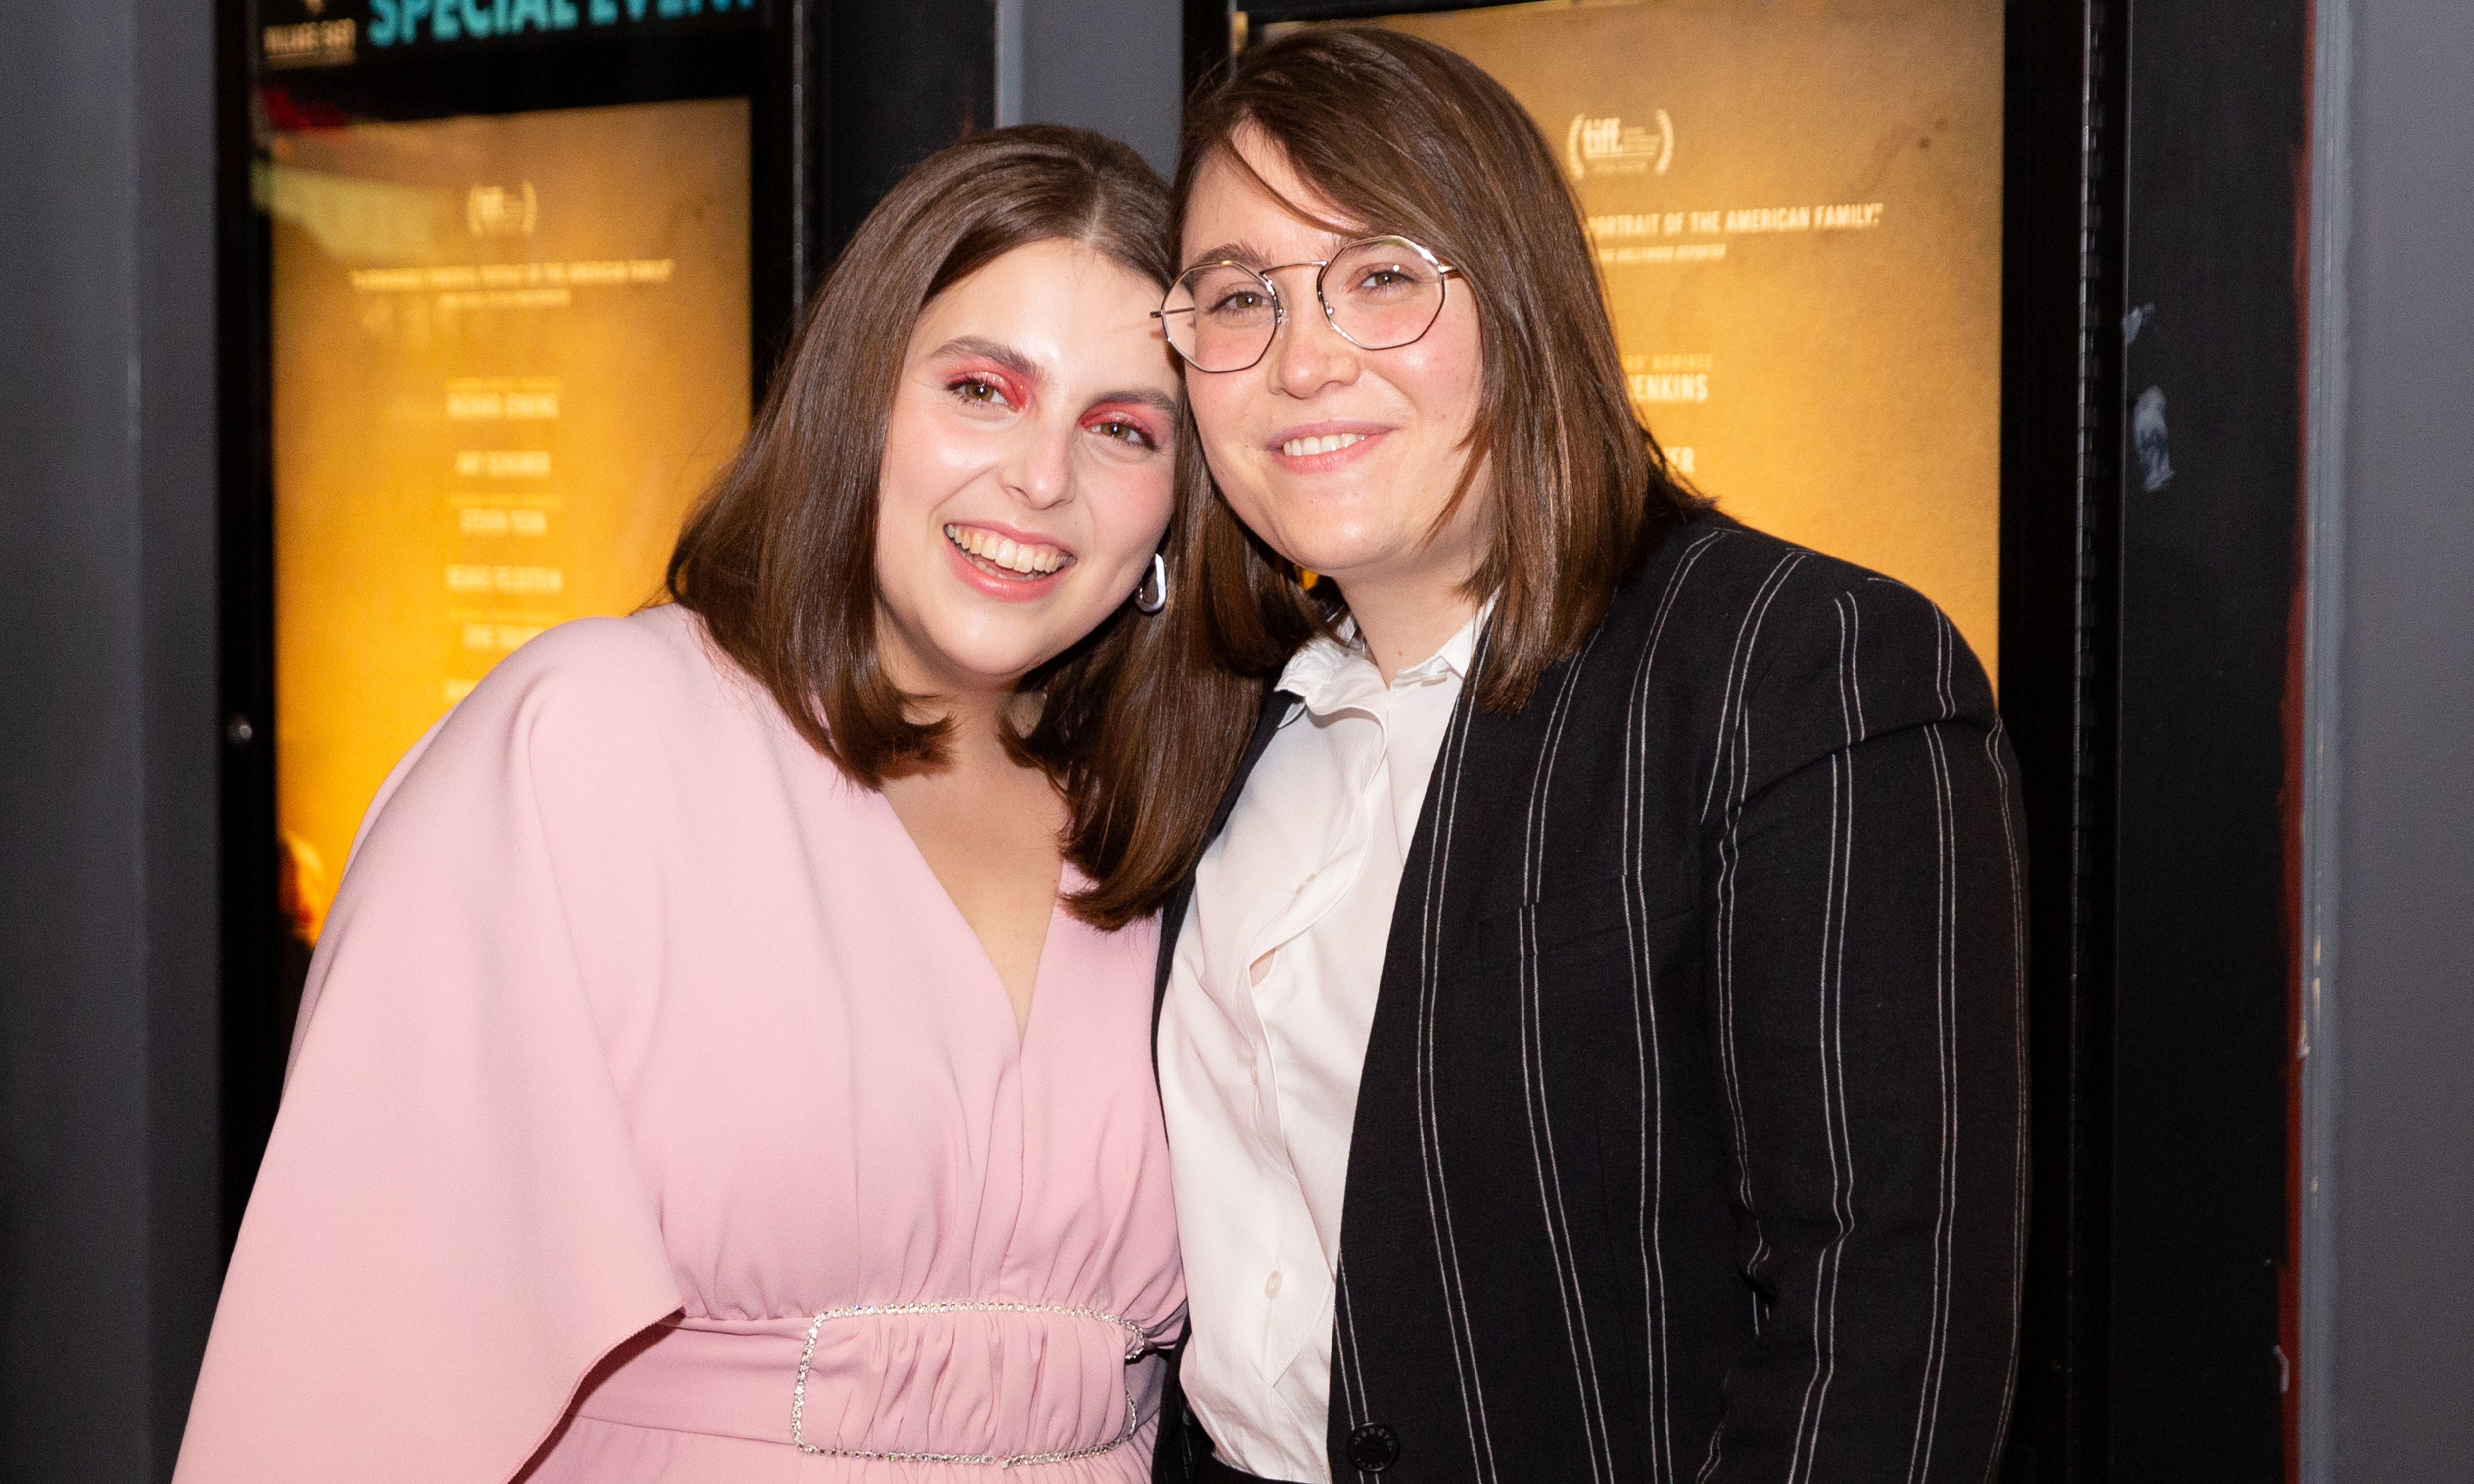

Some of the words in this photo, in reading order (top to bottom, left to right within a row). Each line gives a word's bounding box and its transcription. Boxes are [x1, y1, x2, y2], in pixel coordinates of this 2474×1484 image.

[1663, 212, 1684, 236] OF
[1690, 210, 1721, 234] THE
[1725, 207, 1810, 232] AMERICAN
